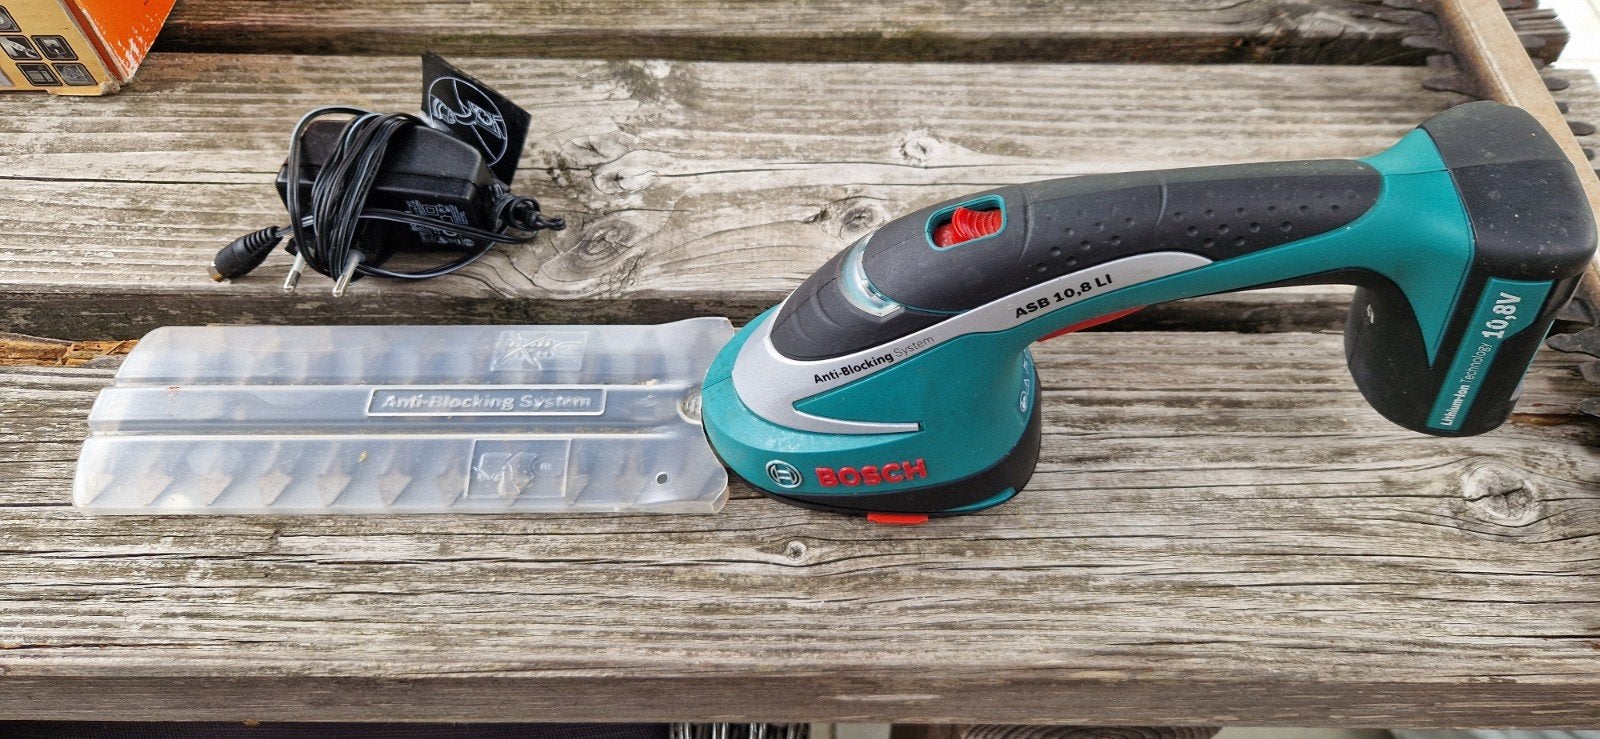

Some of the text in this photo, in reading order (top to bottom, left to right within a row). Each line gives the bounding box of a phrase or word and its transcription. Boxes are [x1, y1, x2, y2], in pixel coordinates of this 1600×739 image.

[1015, 273, 1113, 319] ASB 10,8 LI
[813, 335, 935, 384] Anti-Blocking System
[1440, 291, 1522, 427] Lithium-Ion Technology 10,8V
[382, 393, 592, 411] Anti-Blocking System
[815, 458, 928, 488] BOSCH
